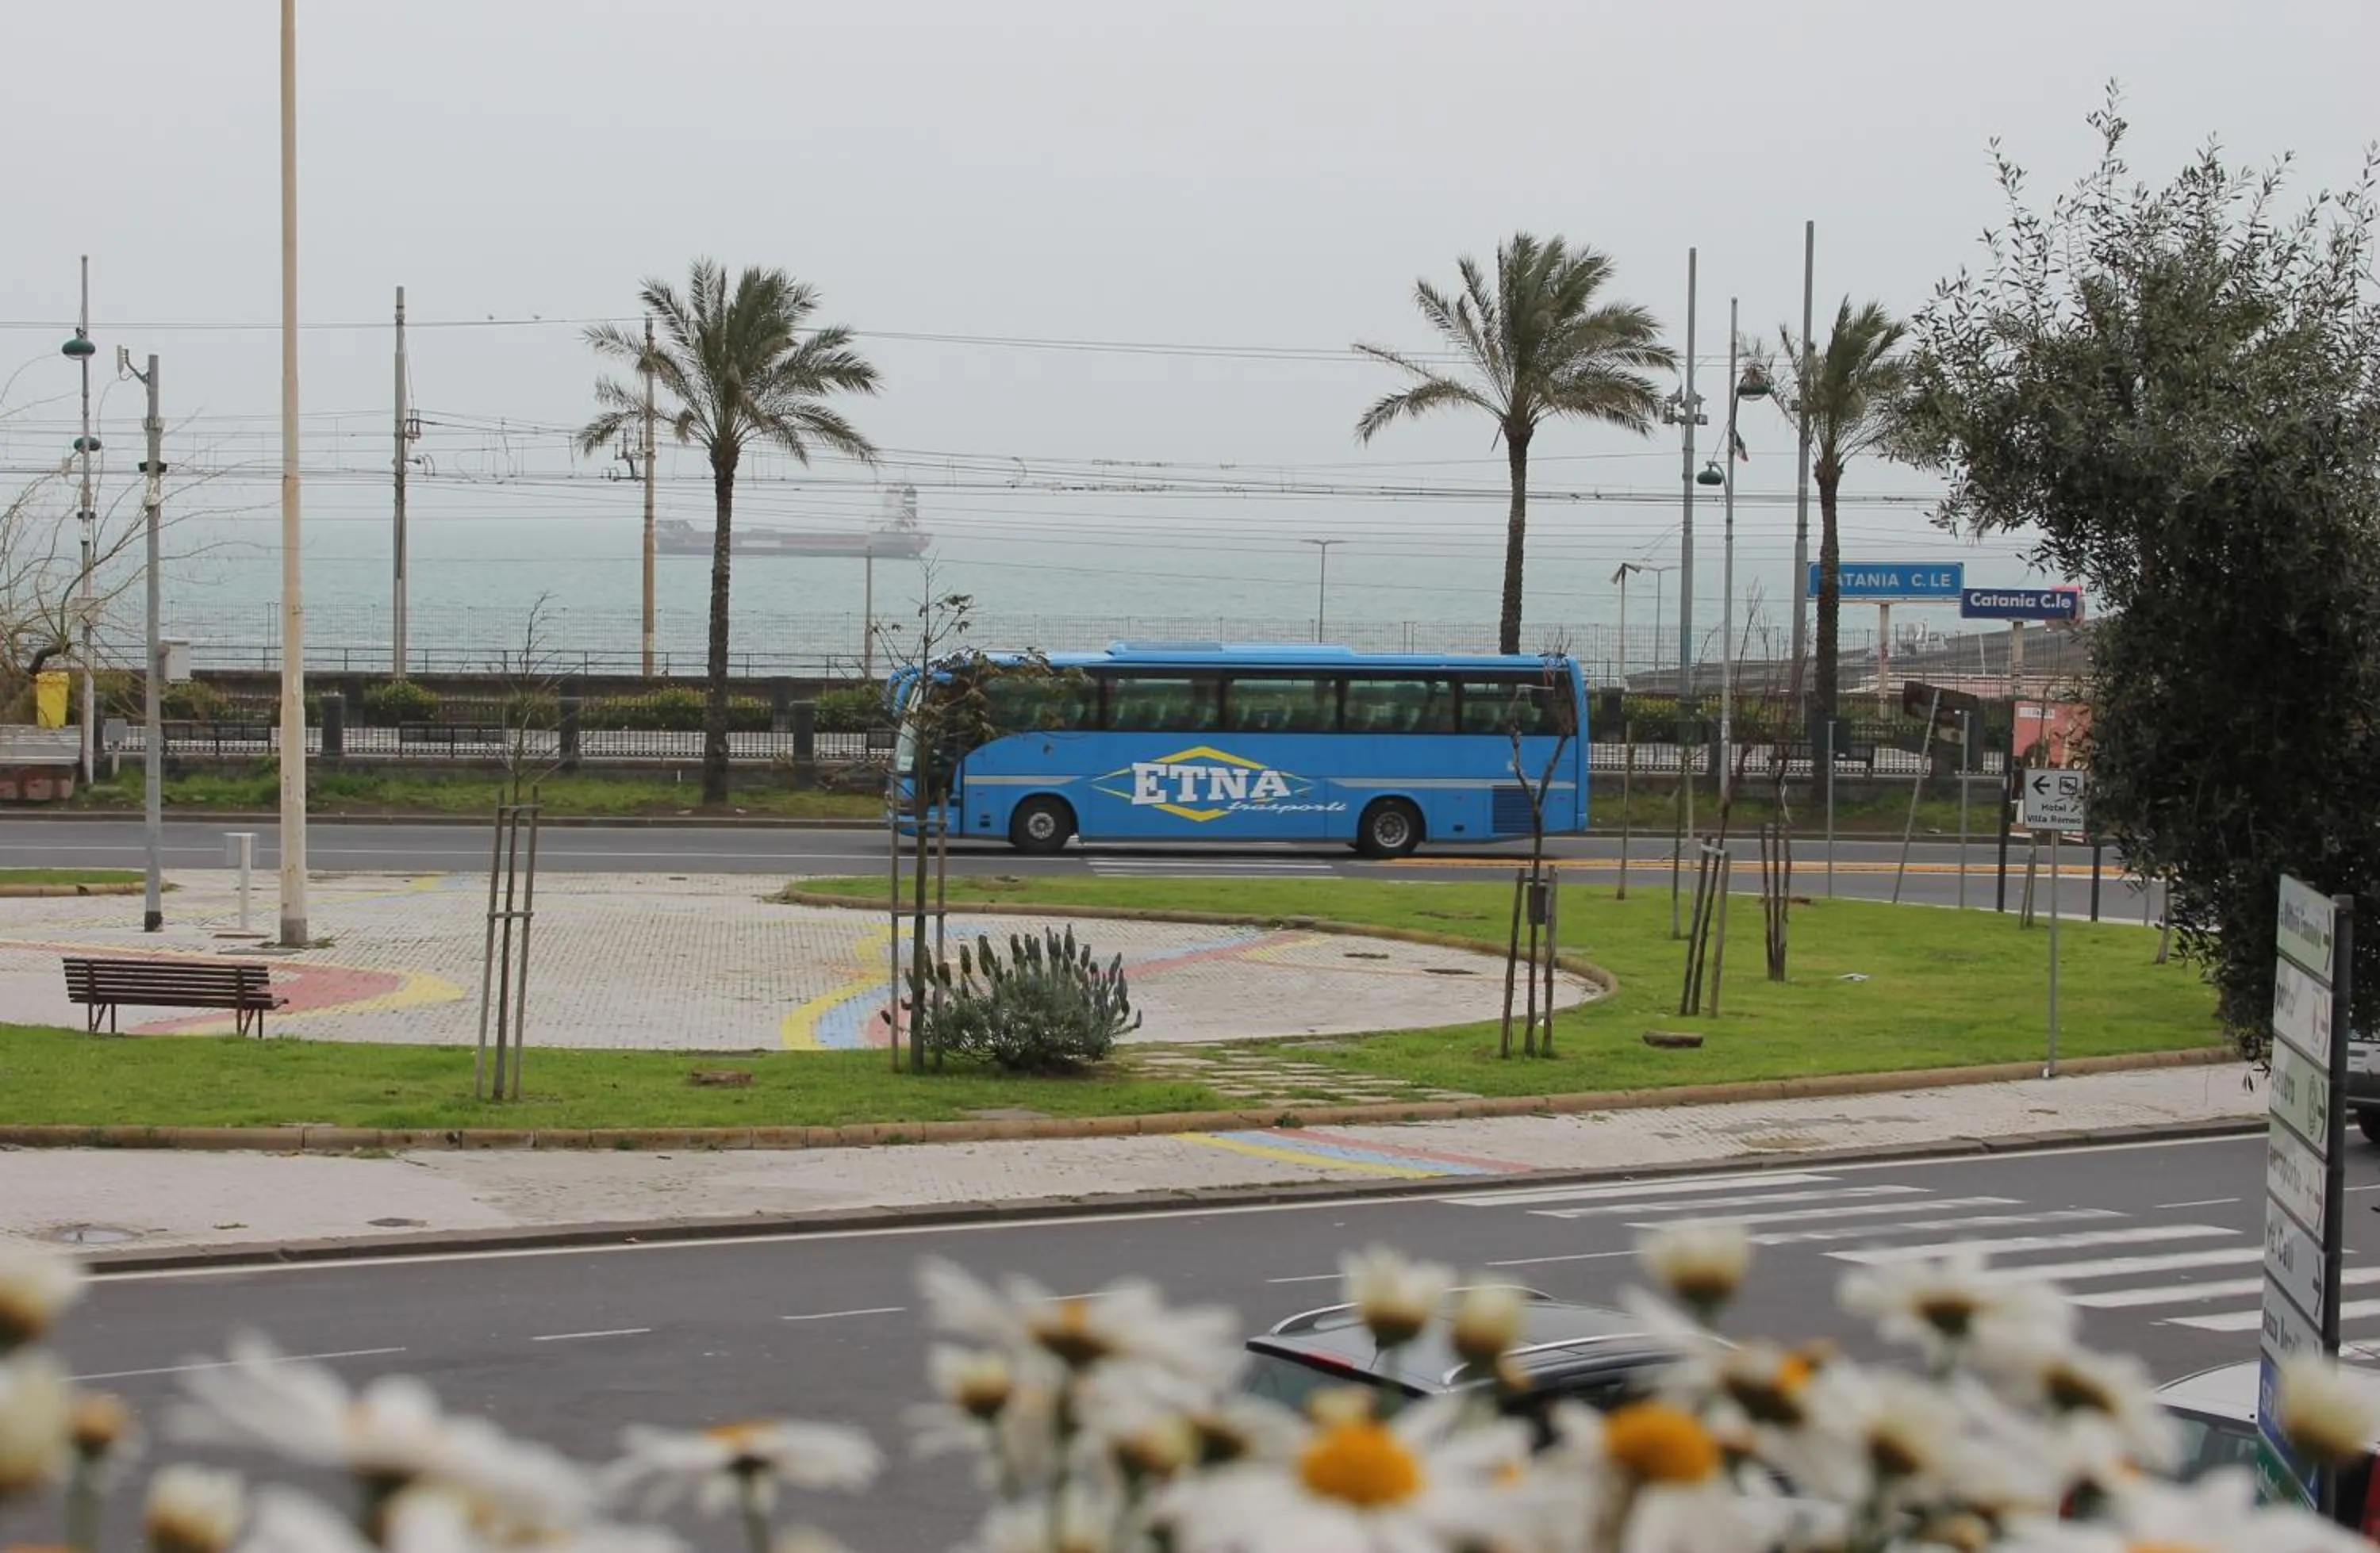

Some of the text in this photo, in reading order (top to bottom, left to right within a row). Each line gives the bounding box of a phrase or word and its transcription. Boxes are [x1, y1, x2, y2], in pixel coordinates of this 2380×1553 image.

[1836, 573, 1952, 588] ATANIA C.LE
[1970, 592, 2071, 609] Catania C.le
[1131, 762, 1291, 804] ETNA
